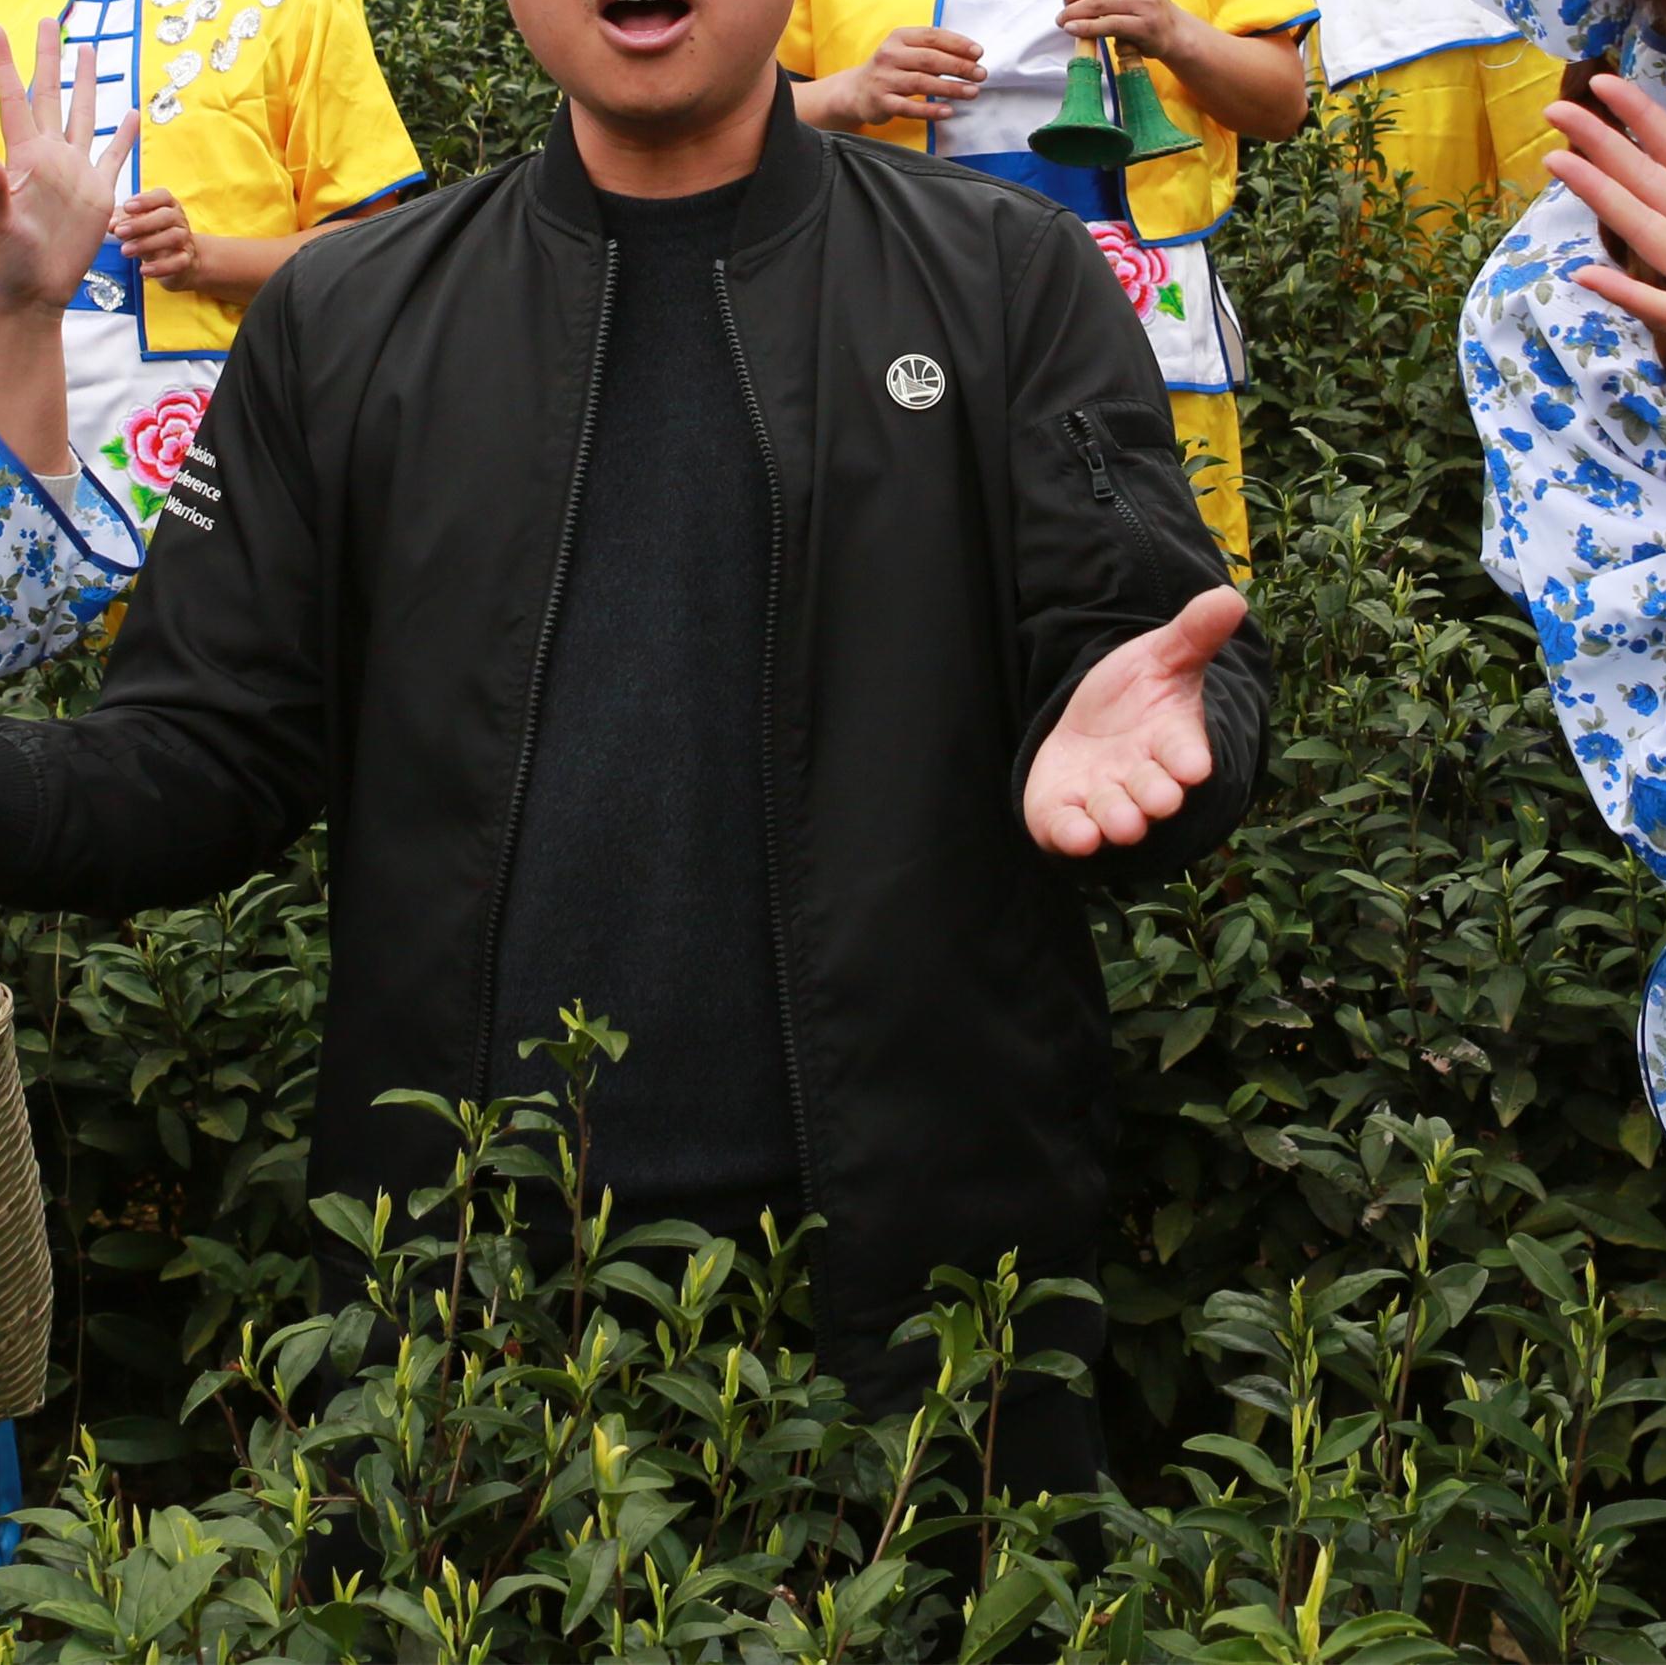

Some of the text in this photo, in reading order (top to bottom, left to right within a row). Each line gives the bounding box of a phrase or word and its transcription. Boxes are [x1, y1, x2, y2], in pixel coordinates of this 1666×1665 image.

[185, 440, 217, 469] ivision
[173, 469, 222, 502] nference
[164, 495, 215, 531] Warriors
